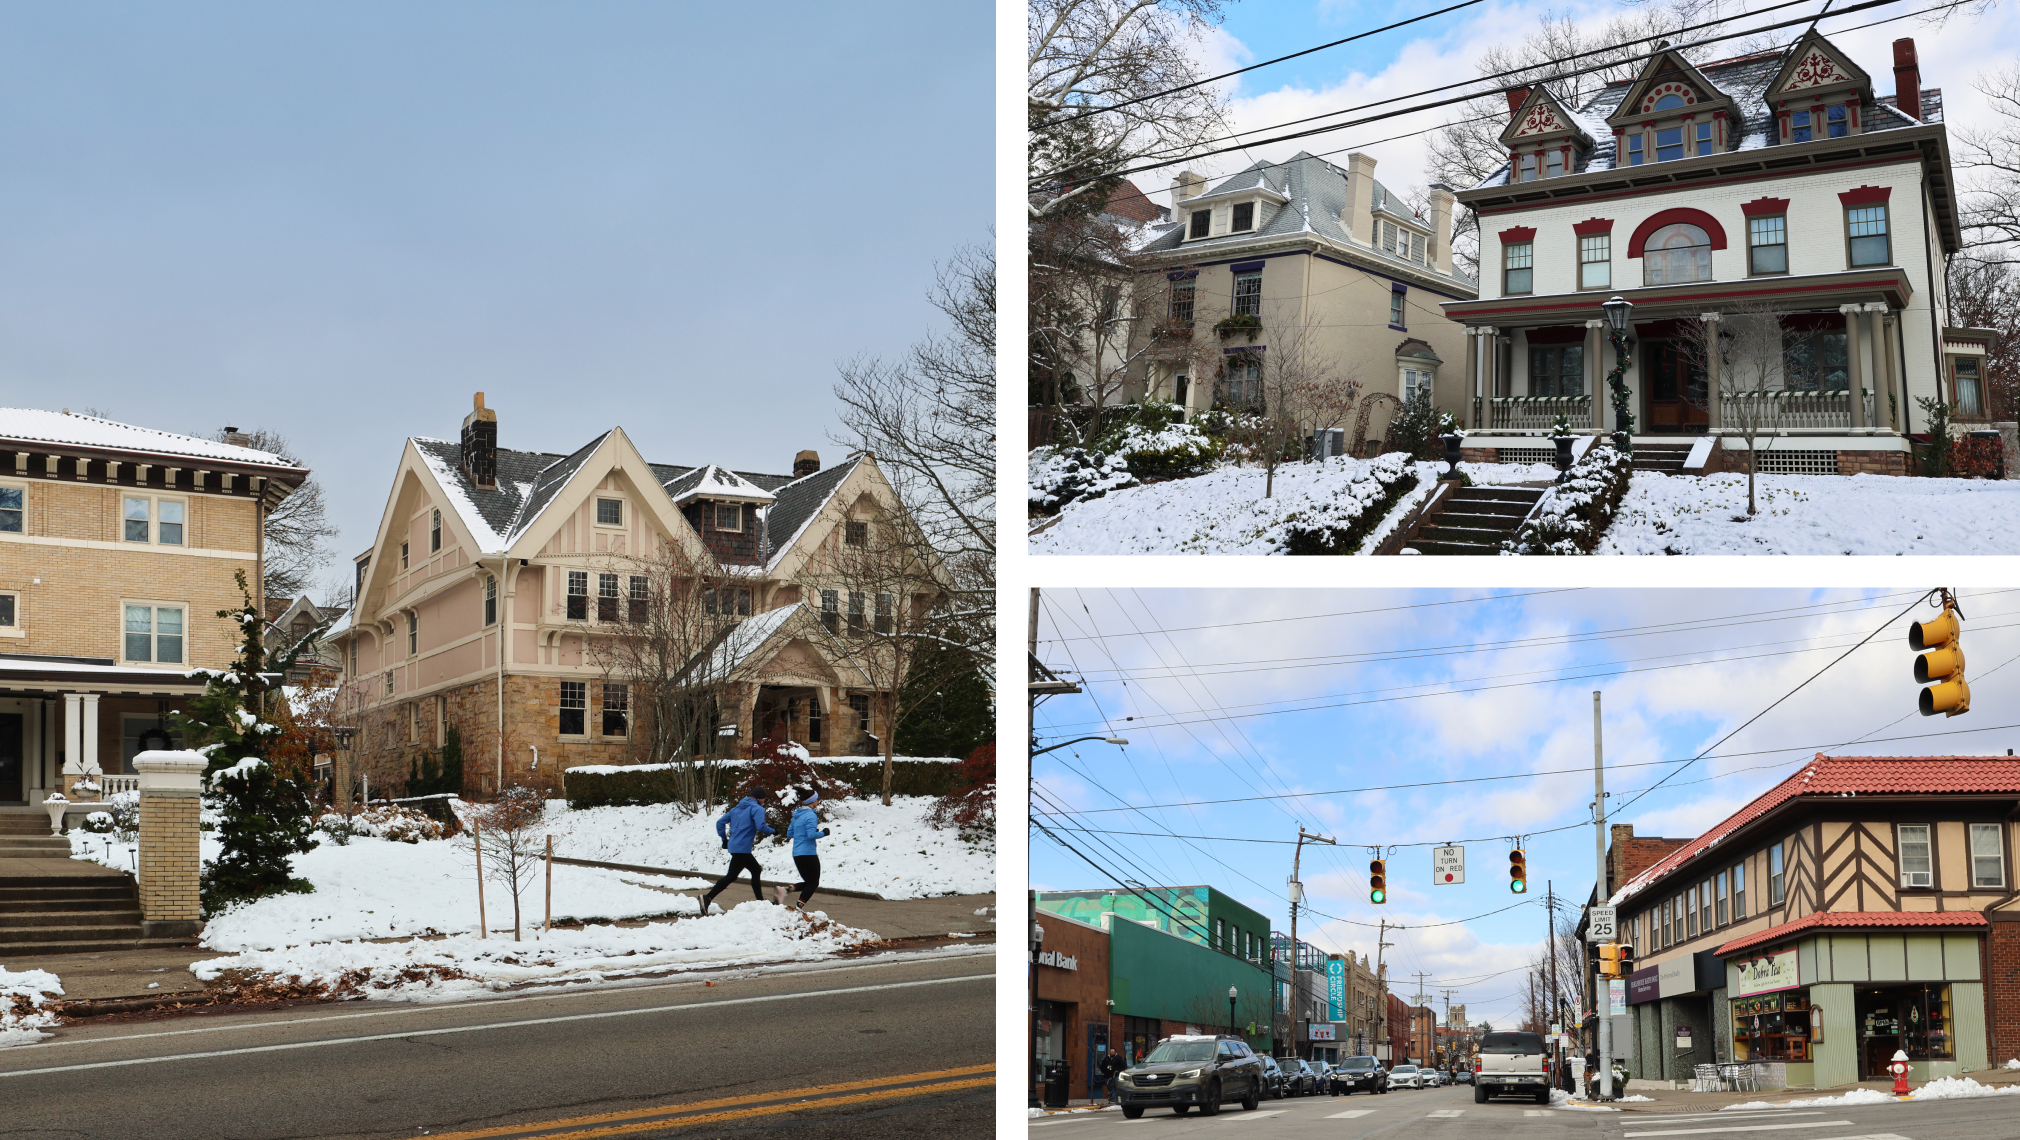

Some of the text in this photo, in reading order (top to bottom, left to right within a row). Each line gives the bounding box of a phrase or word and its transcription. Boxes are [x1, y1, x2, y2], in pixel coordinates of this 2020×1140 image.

[1594, 923, 1612, 935] 25
[1056, 952, 1078, 971] Bank
[1753, 965, 1770, 980] Dobra
[1771, 963, 1781, 976] Tea
